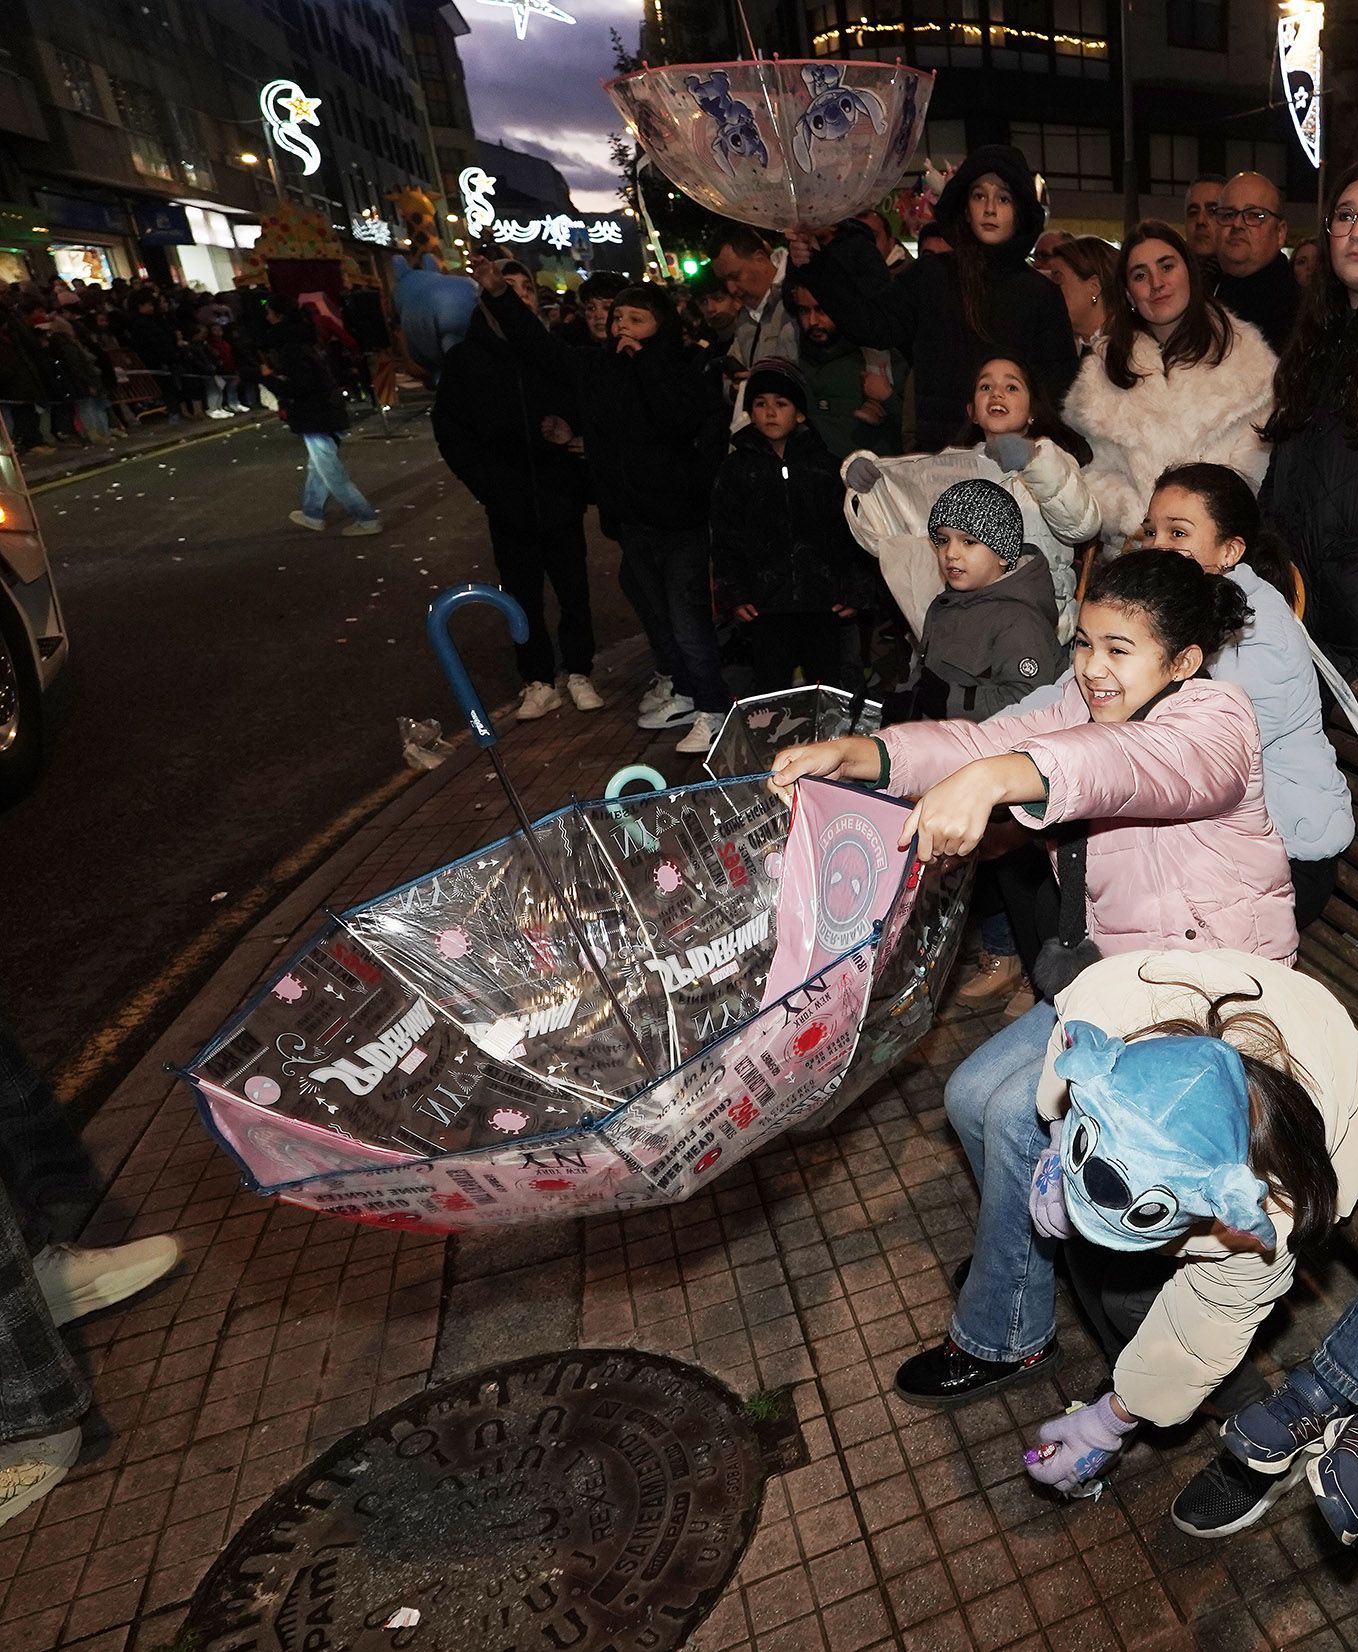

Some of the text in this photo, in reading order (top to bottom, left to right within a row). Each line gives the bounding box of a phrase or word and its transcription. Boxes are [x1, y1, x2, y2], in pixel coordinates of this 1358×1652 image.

[794, 991, 833, 1029] NEW YORK
[696, 1098, 732, 1133] CRIME
[518, 1148, 591, 1170] NY
[650, 1131, 698, 1177] FIGHTER
[655, 1131, 716, 1191] WEB HEAD
[581, 1459, 617, 1545] REXEL
[615, 1432, 669, 1575] SANEAMIENTO
